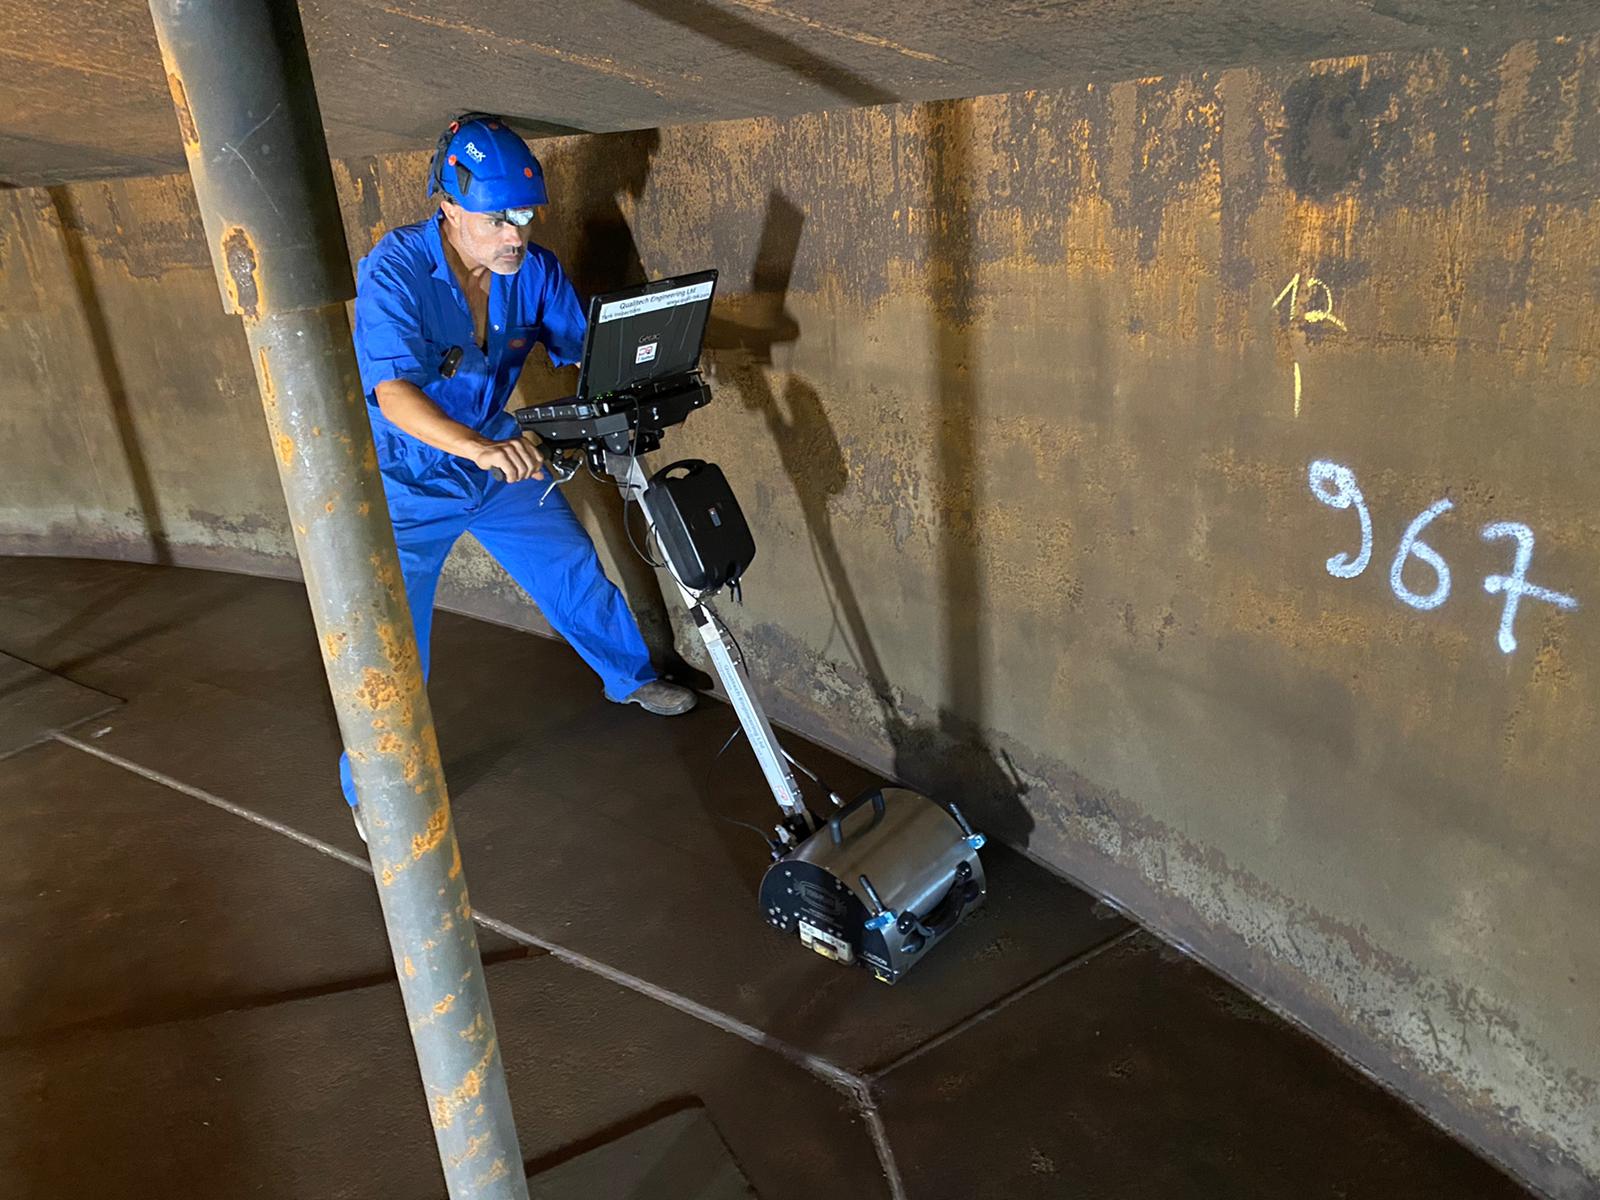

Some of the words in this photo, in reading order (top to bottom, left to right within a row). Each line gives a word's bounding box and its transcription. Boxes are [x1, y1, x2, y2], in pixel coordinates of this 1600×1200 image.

[650, 289, 686, 303] Engineering
[686, 287, 697, 296] Ltd
[1271, 273, 1347, 331] 12
